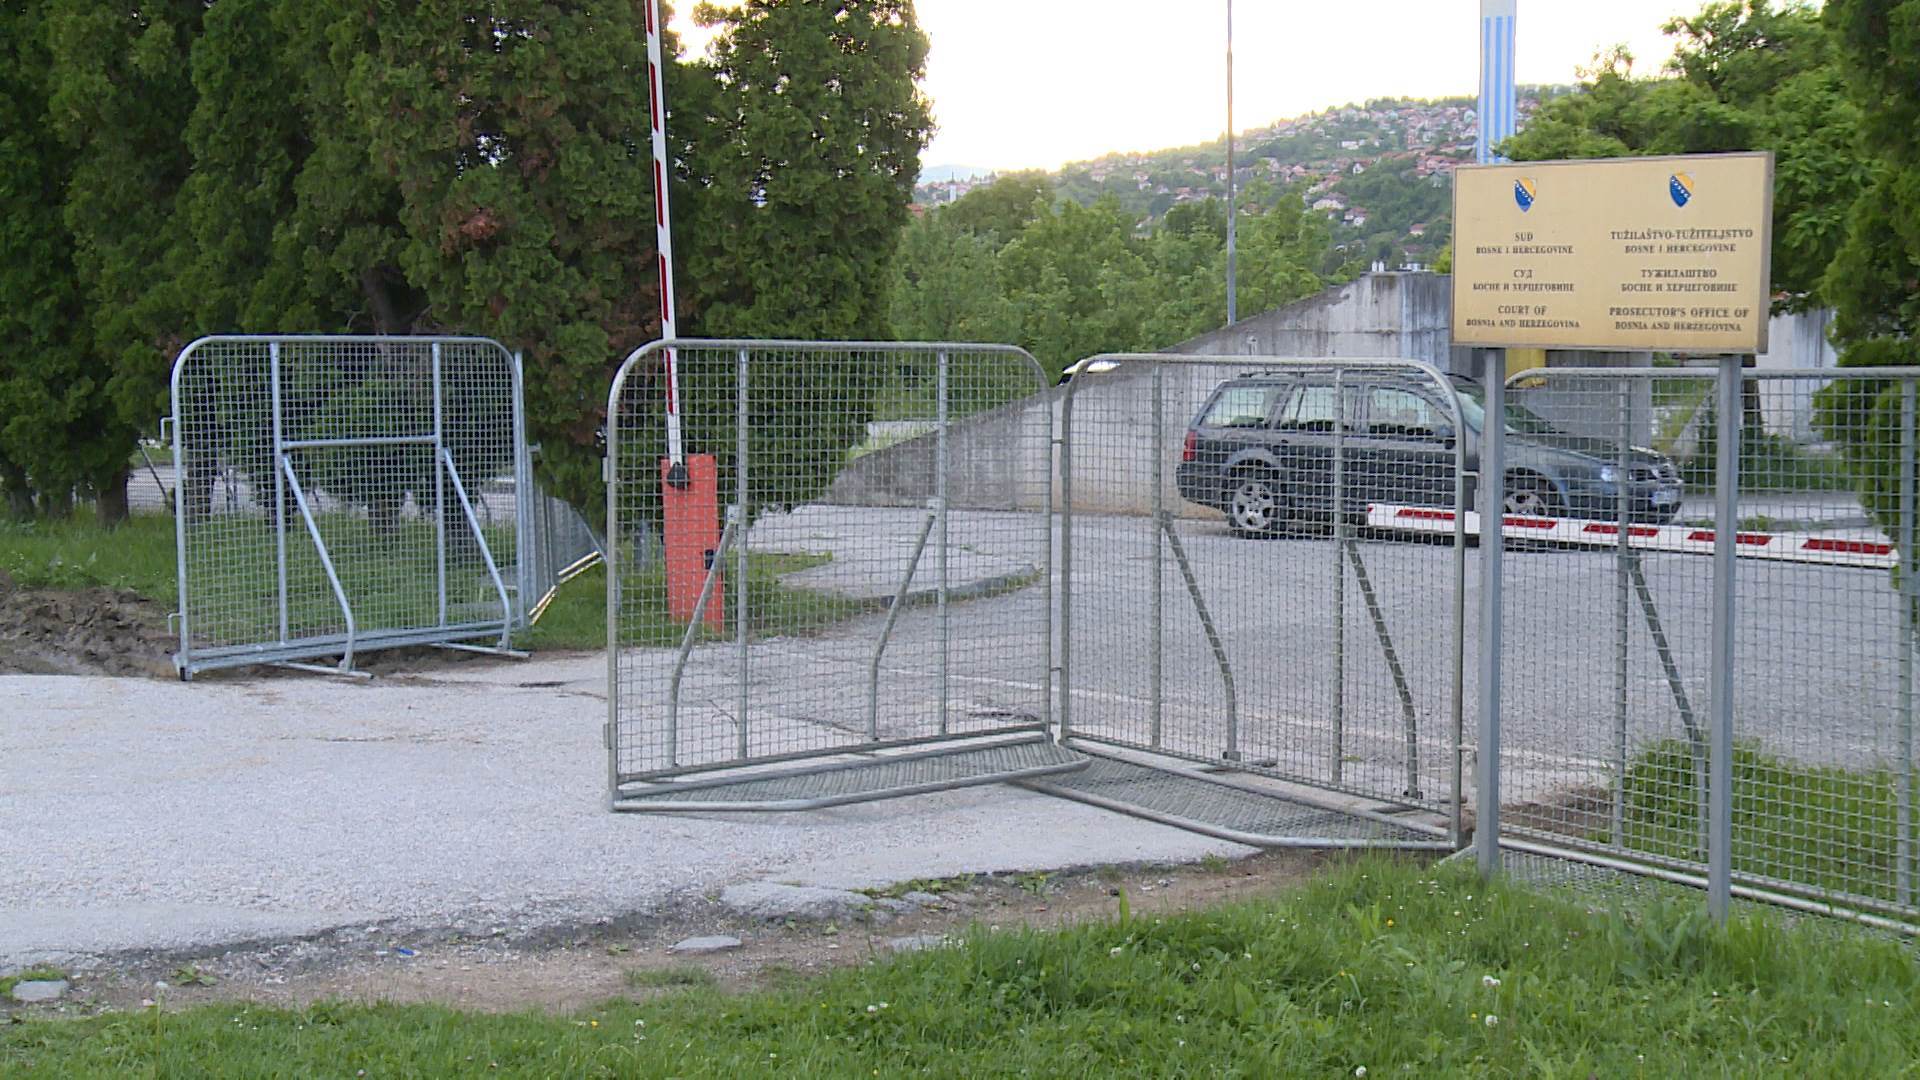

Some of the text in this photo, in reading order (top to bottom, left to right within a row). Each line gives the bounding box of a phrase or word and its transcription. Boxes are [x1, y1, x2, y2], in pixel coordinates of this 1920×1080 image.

[1515, 232, 1534, 241] SUD
[1610, 228, 1753, 240] TUŽILAŠTVO-TUŽITELJSTVO
[1476, 245, 1502, 254] BOSNE
[1512, 245, 1574, 254] HERCEGOVINE
[1625, 245, 1655, 254] BOSNE
[1666, 244, 1736, 253] HERCEGOVINE
[1513, 269, 1533, 279] СУД
[1473, 283, 1500, 291] БОСНЕ
[1621, 283, 1738, 292] БОСНЕ И ХЕРЦЕГОВИНЕ
[1498, 305, 1547, 315] COURT OF
[1609, 307, 1750, 317] PROSECUTOR'S OFFICE OF
[1466, 319, 1580, 328] BOSNIA AND HERZEGOVINA
[1615, 321, 1741, 332] BOSNIA AND HERZEGOVINA
